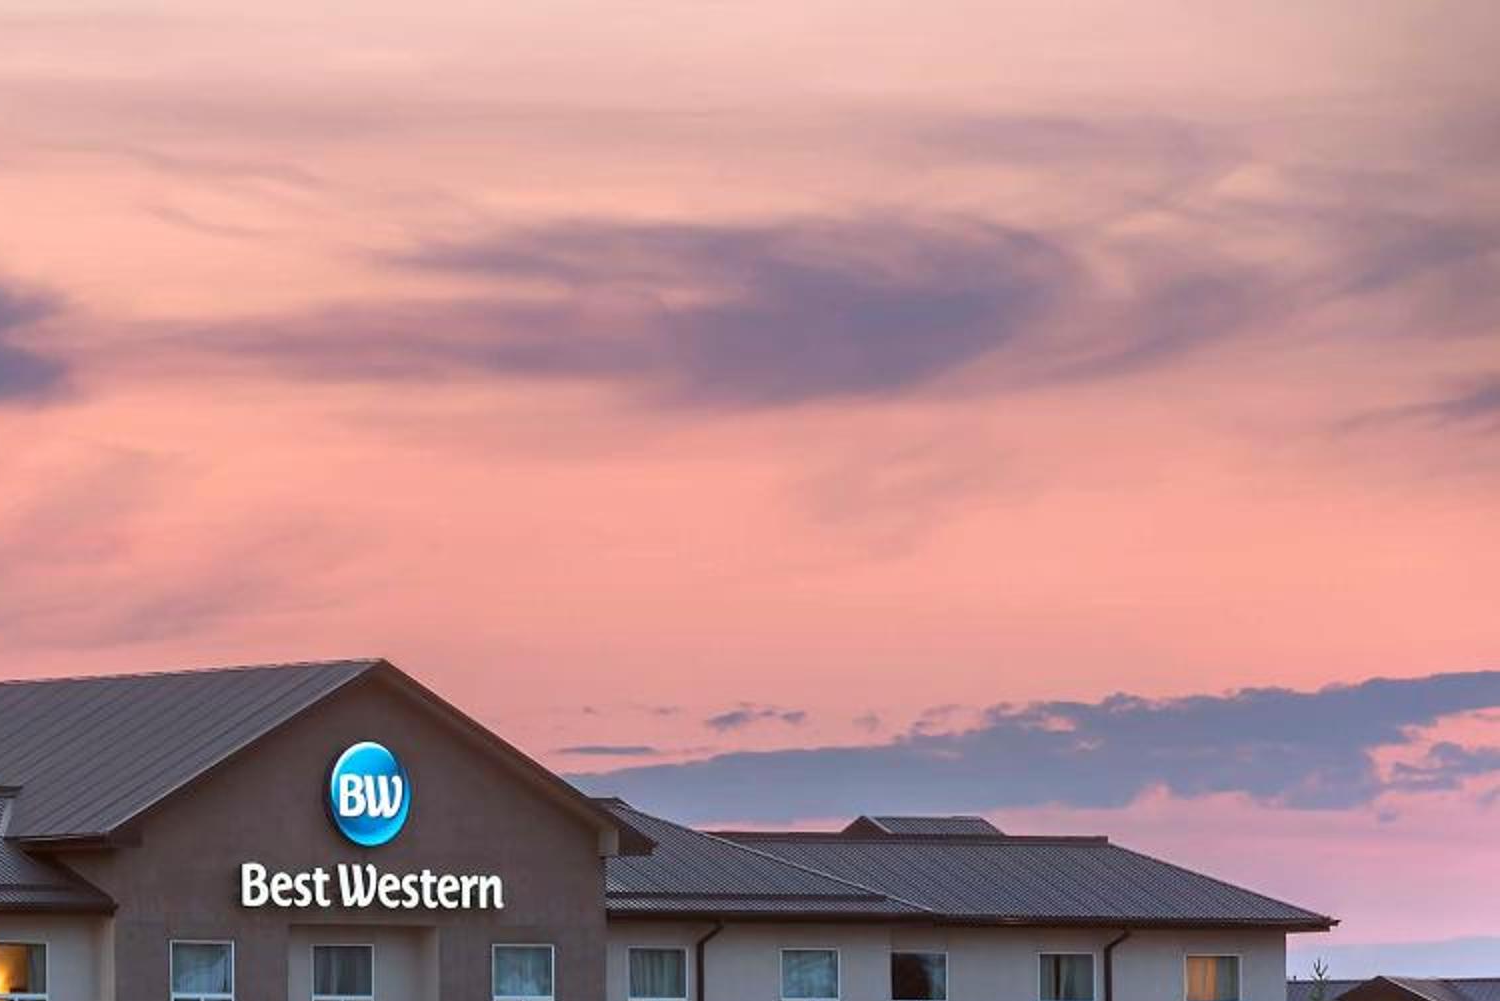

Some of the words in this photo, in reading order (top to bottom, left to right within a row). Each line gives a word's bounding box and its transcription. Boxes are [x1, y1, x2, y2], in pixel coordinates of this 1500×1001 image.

[339, 773, 403, 818] BW
[241, 863, 331, 908] Best
[337, 863, 504, 909] Western
